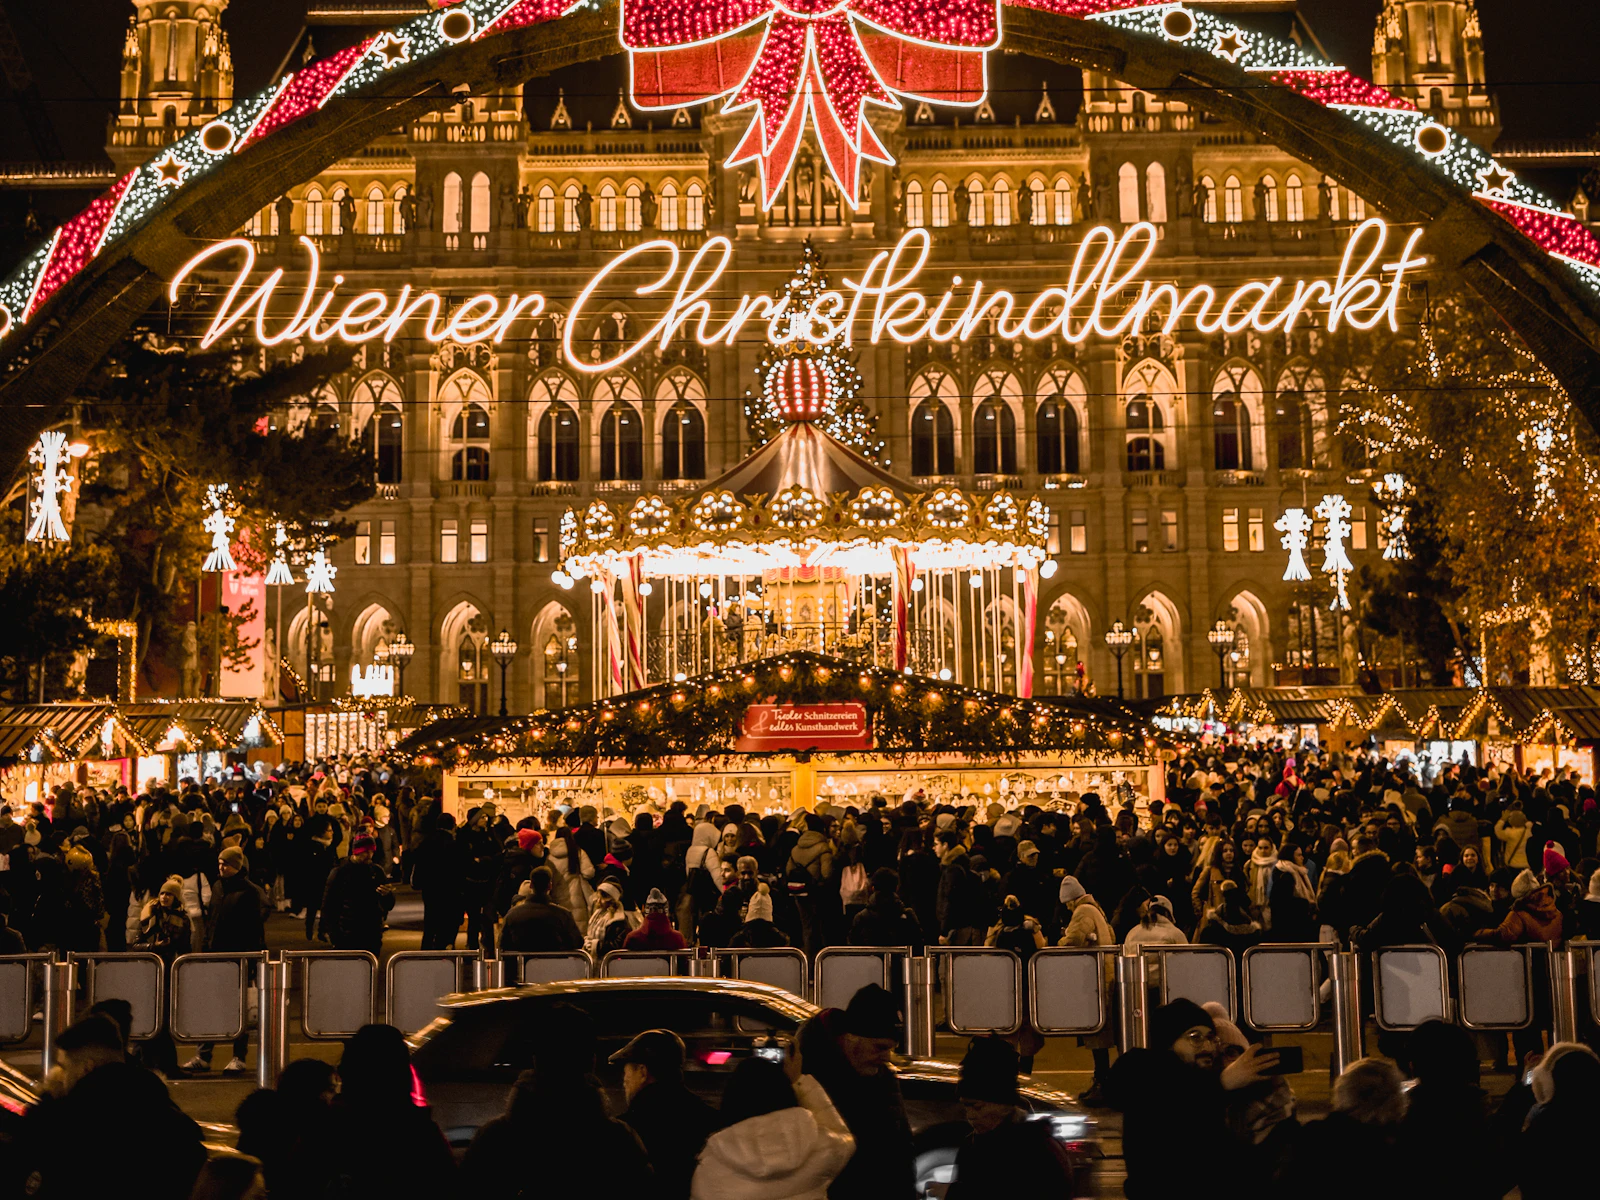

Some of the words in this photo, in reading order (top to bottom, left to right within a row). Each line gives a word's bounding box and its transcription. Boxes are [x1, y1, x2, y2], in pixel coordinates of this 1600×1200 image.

[170, 235, 544, 349] Wiener
[564, 218, 1427, 372] Christkindlmarkt
[751, 711, 768, 733] &
[769, 721, 794, 732] edles
[795, 722, 859, 732] Kunsthandwerk
[771, 709, 802, 721] Tiroler
[804, 711, 858, 721] Schnitzereien
